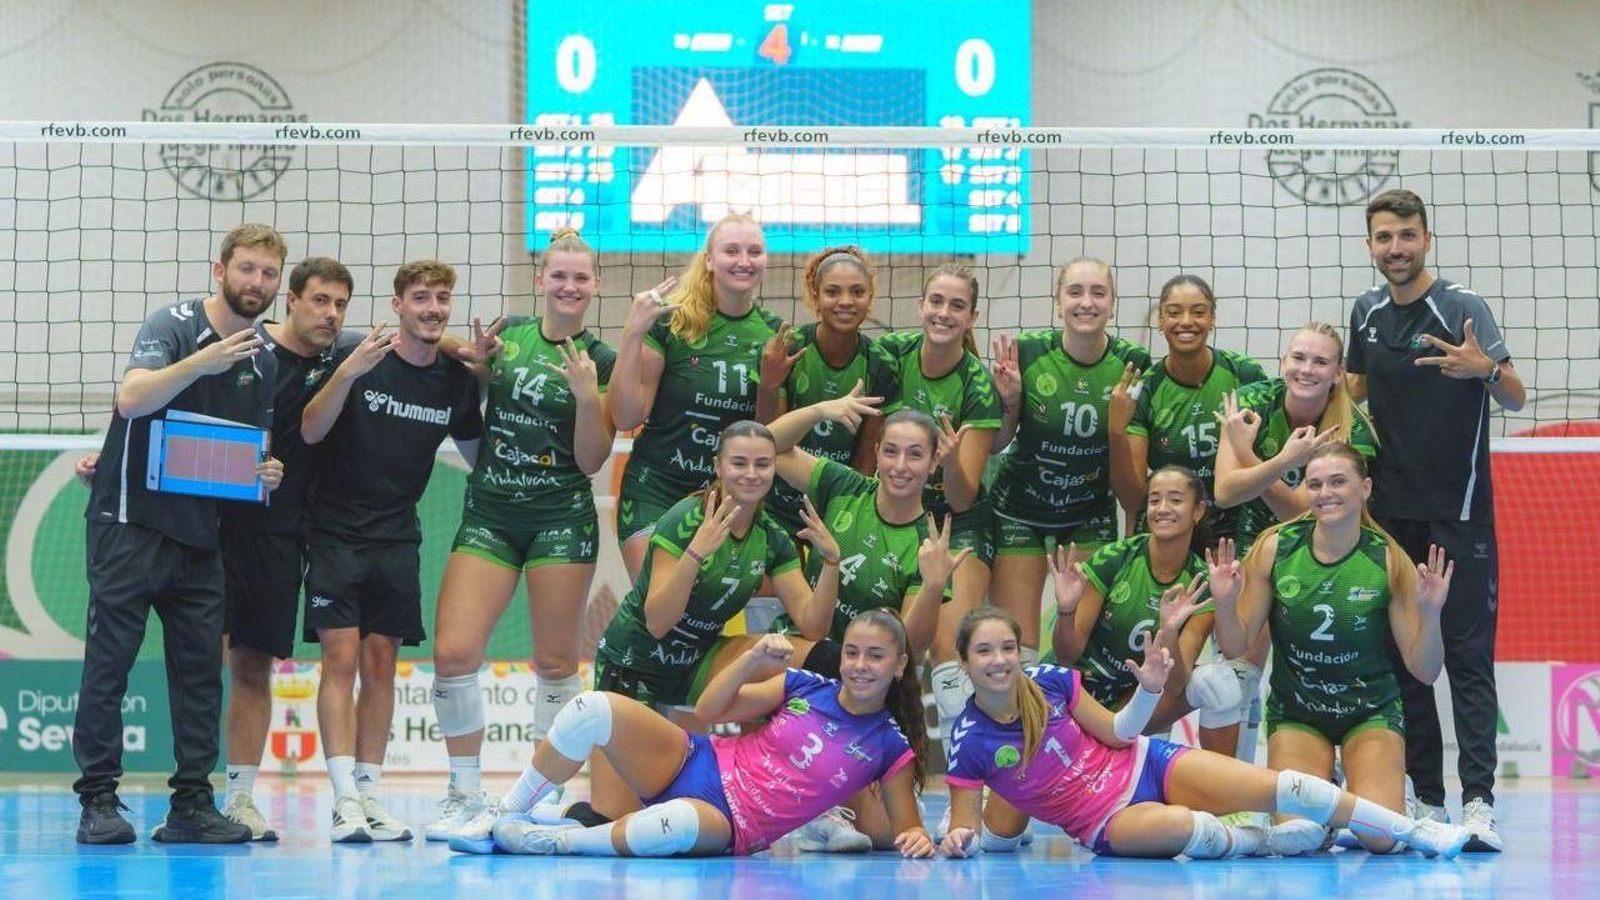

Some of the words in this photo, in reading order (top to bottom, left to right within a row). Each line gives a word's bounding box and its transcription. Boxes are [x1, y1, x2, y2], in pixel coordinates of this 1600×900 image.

[759, 23, 791, 64] 4
[556, 35, 596, 93] 0
[955, 39, 995, 97] 0
[175, 76, 204, 106] solo
[208, 69, 278, 105] personas
[1281, 83, 1309, 112] solo
[1313, 74, 1382, 112] personas
[41, 123, 125, 136] rfevb.com
[275, 125, 360, 139] rfevb.com
[510, 126, 594, 140] rfevb.com
[744, 128, 828, 142] rfevb.com
[977, 129, 1061, 143] rfevb.com
[1210, 130, 1293, 144] rfevb.com
[1441, 131, 1524, 144] rfevb.com
[511, 367, 547, 406] 14
[712, 360, 749, 396] 11
[385, 395, 451, 426] hummel
[1061, 401, 1098, 438] 10
[1181, 422, 1218, 458] 15
[579, 541, 592, 557] 14
[839, 553, 867, 586] 4
[710, 577, 740, 611] 7
[1310, 604, 1335, 641] 2
[789, 733, 823, 770] 3
[1044, 737, 1072, 769] 1
